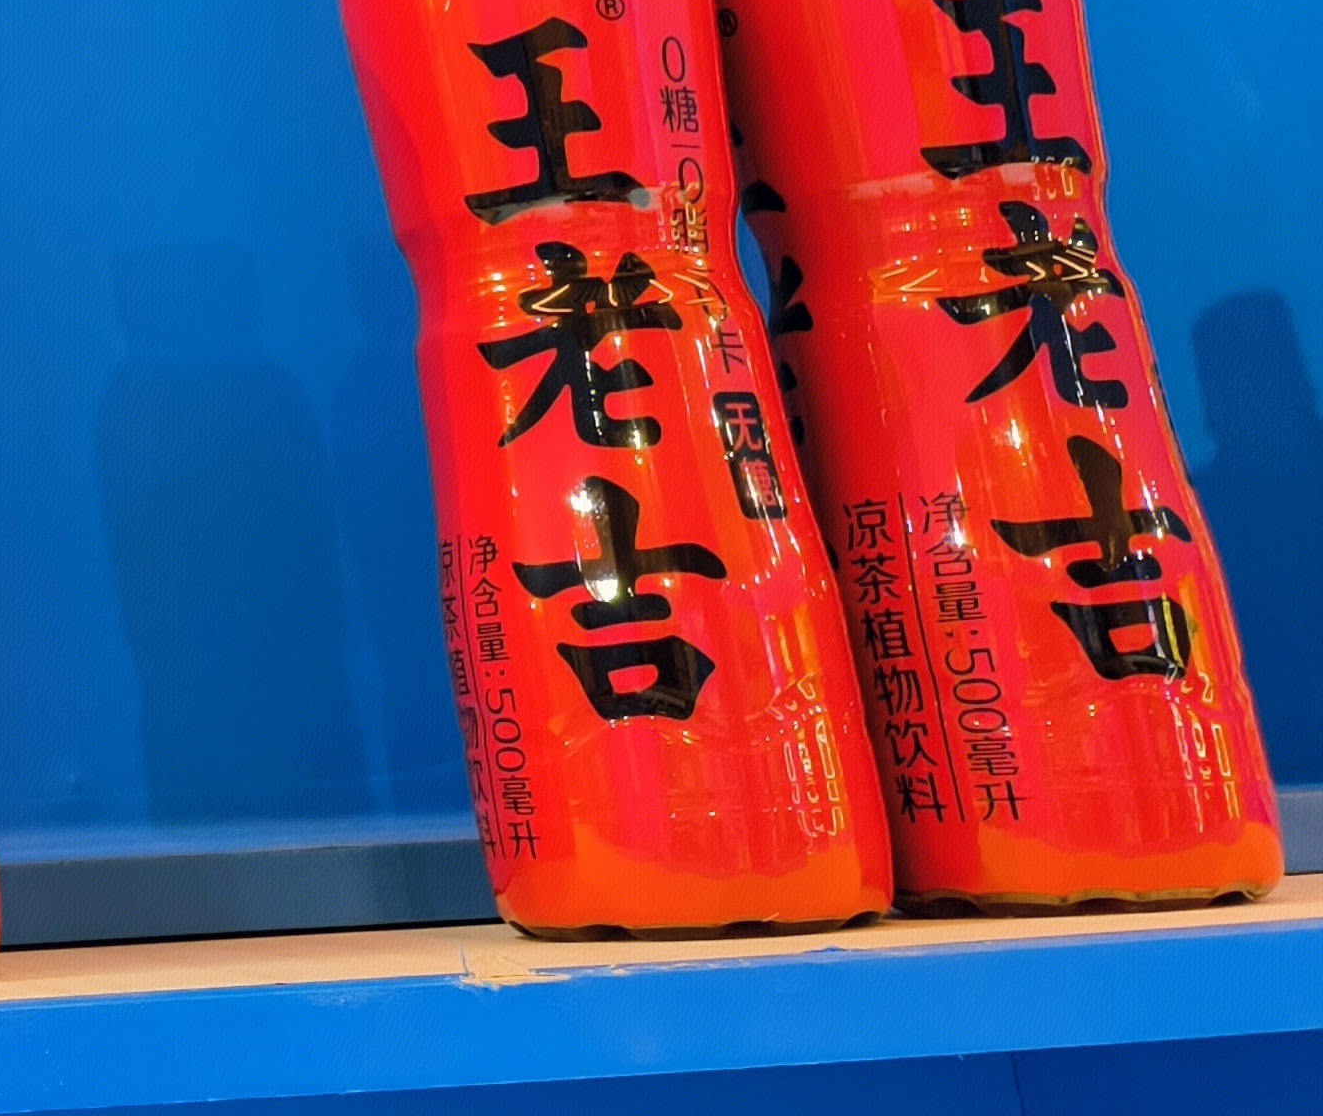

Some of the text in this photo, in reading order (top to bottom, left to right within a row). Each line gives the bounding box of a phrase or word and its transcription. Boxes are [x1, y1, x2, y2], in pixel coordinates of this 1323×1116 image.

[464, 17, 727, 720] 王老吉
[843, 496, 948, 823] 凉茶植物饮料
